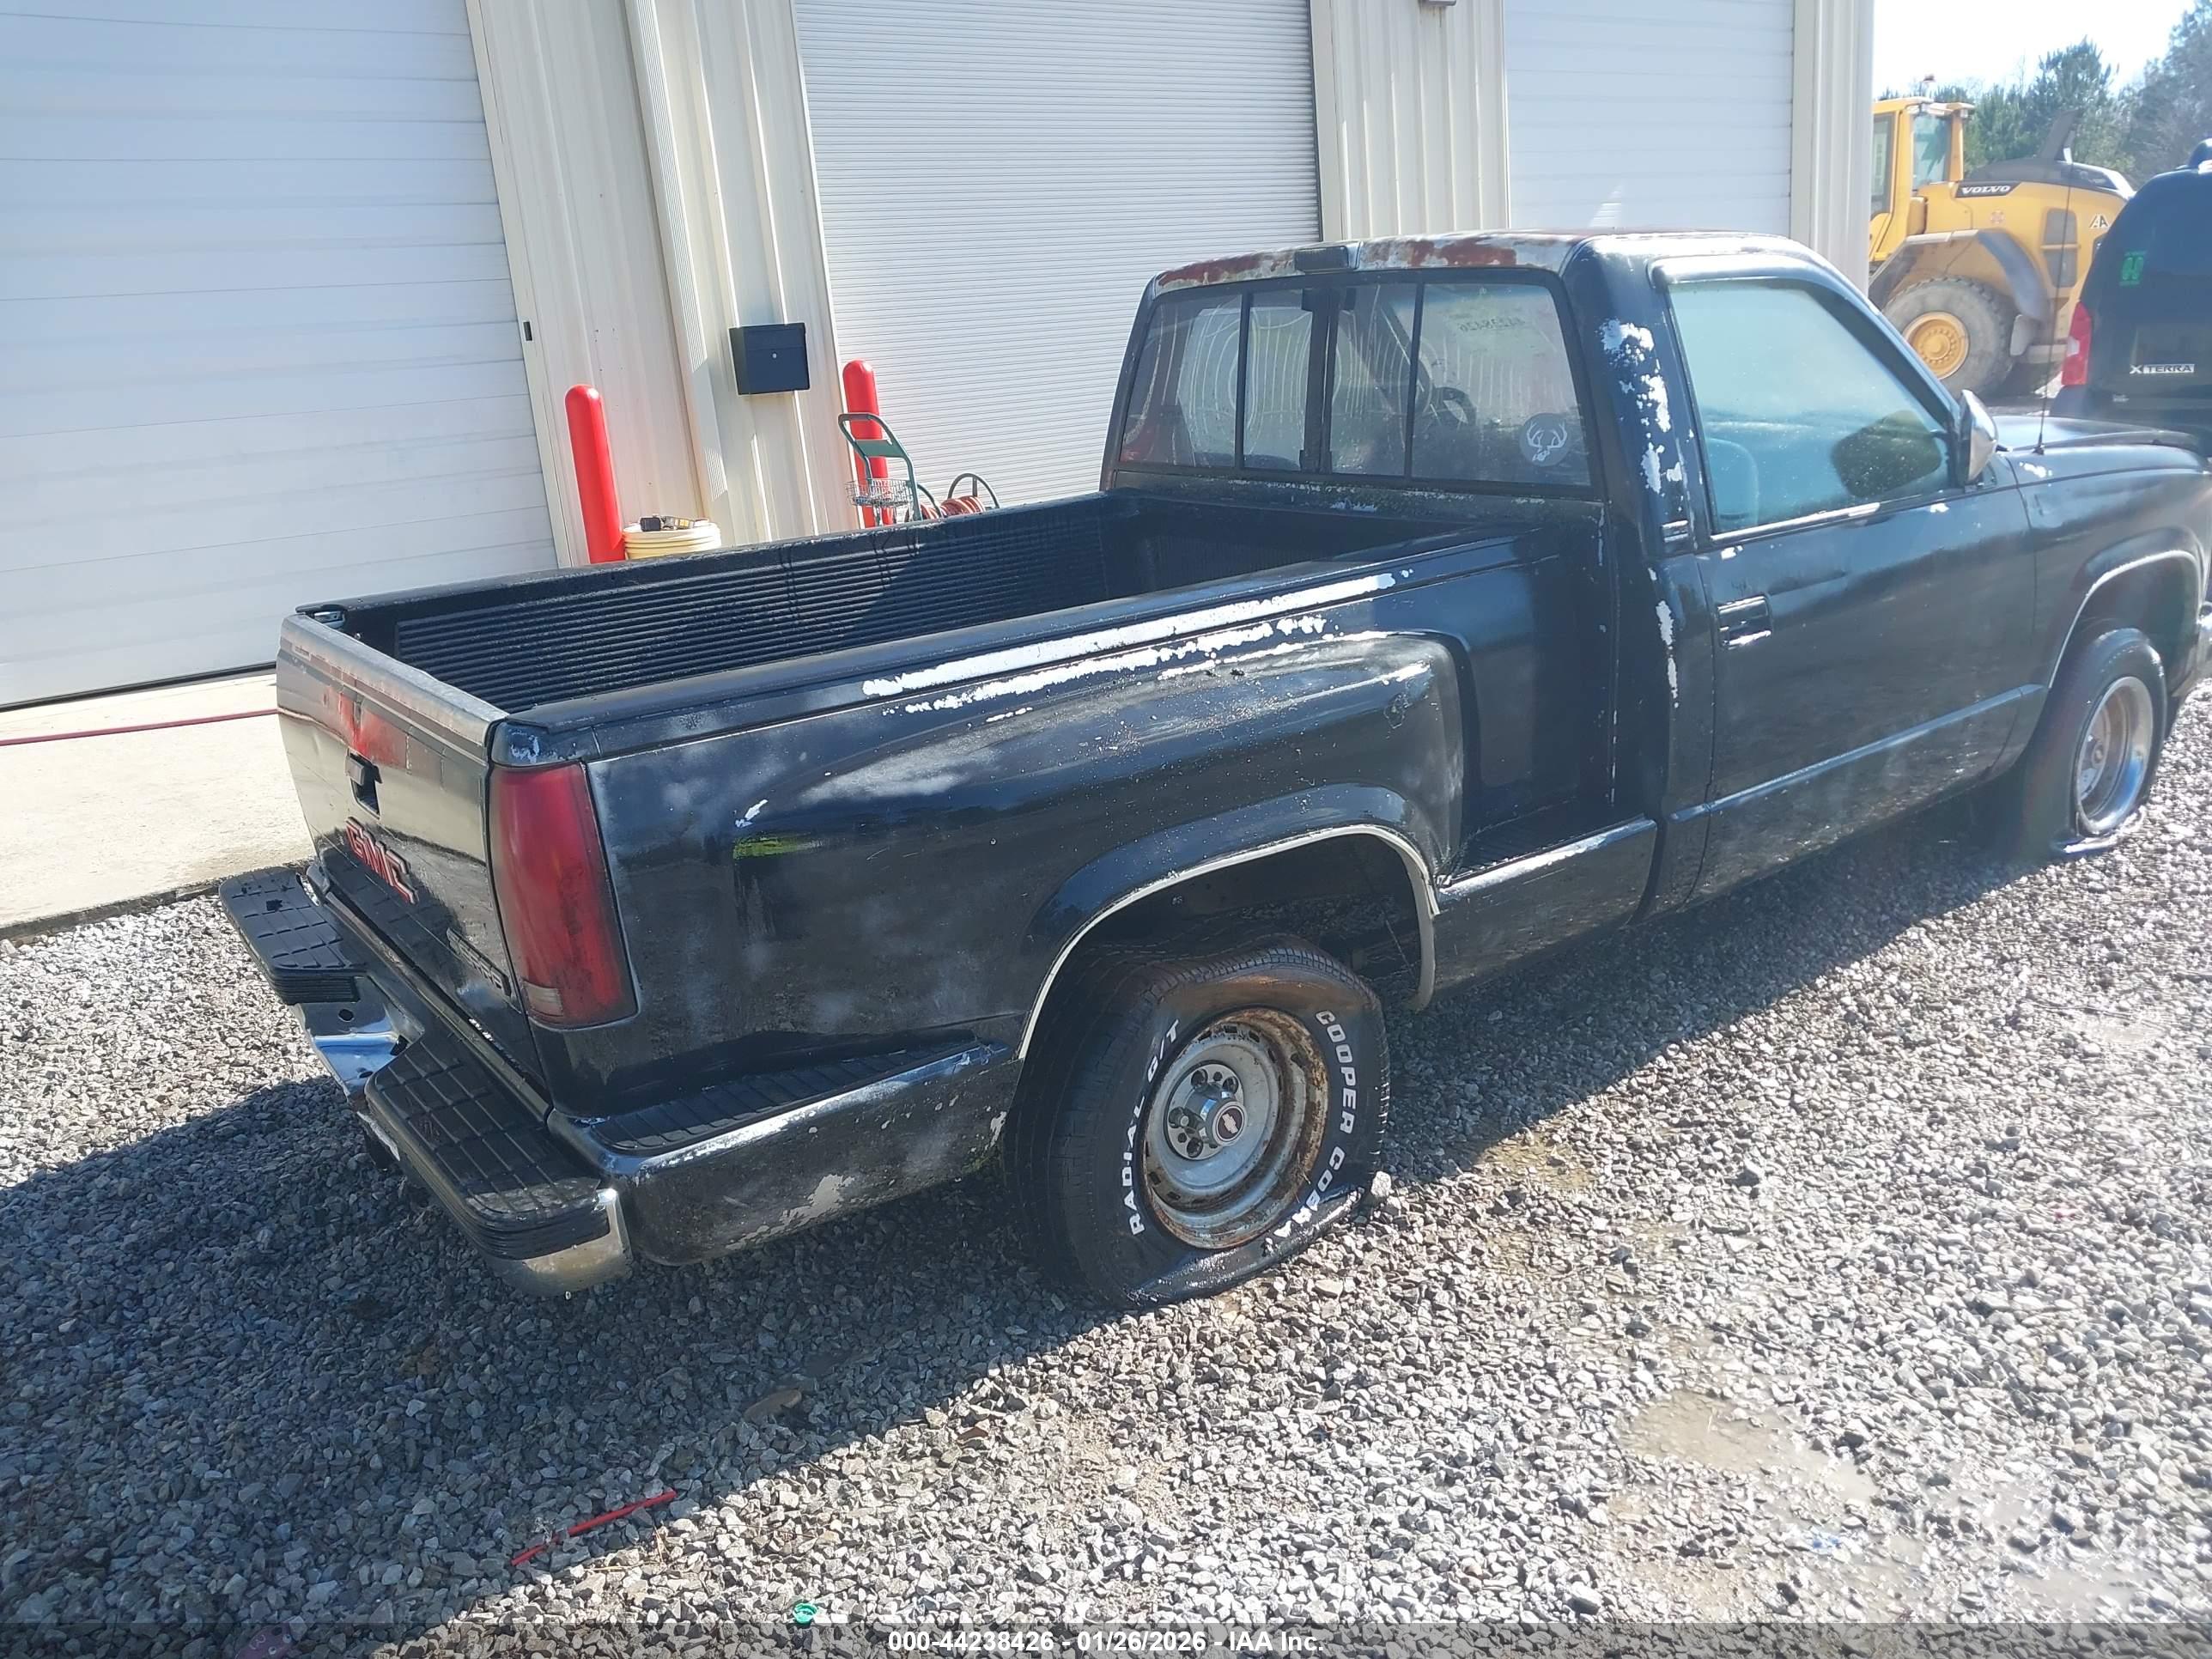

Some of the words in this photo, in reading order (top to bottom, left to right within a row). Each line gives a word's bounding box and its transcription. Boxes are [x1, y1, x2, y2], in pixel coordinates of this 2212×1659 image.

[1962, 185, 2011, 195] VOLVO
[2130, 364, 2196, 374] XTERRA
[345, 817, 416, 904] GMC
[1316, 1010, 1357, 1134] COOPER
[1121, 1096, 1146, 1236] RADIAL
[1147, 1018, 1180, 1083] G/T
